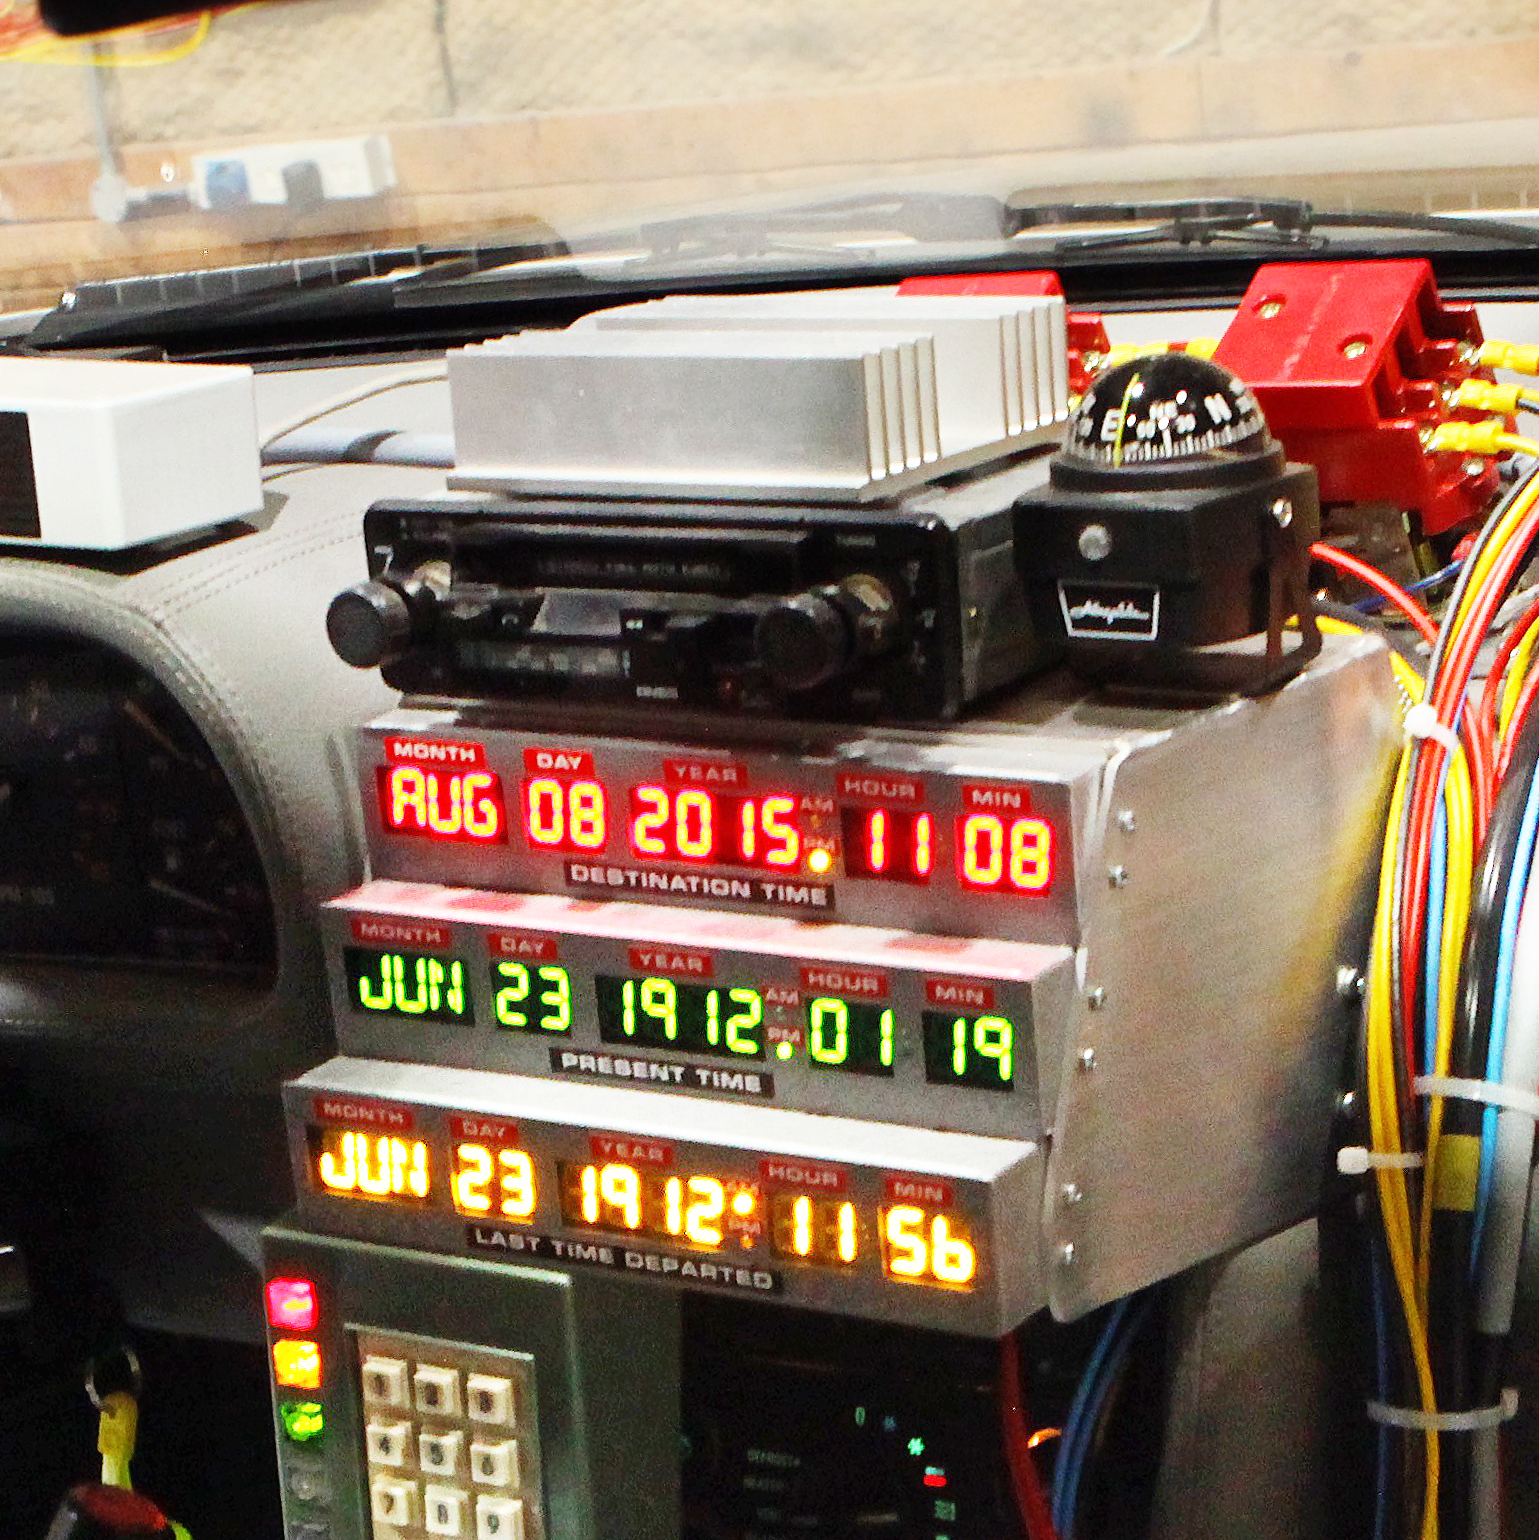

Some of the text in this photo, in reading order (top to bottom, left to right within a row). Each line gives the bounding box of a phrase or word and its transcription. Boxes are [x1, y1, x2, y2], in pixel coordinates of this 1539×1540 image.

[394, 741, 1022, 809] MONTH DAY YEAR HOUR MIN
[800, 796, 834, 813] AM
[390, 765, 499, 838] AUG
[528, 777, 606, 848] 08
[870, 808, 930, 876] 11
[963, 813, 1052, 890] 08
[570, 864, 827, 906] DESTINATION TIME
[359, 923, 984, 1005] MONTH DAY YEAR HOUR MIN
[766, 987, 800, 1005] AM
[358, 953, 465, 1015] JUN
[496, 961, 572, 1032] 23
[809, 996, 893, 1067] 01
[952, 1015, 1014, 1082] 19
[767, 1026, 802, 1042] PM
[560, 1052, 761, 1093] PRESENT TIME
[323, 1103, 944, 1201] MONTH DAY YEAR HOUR MIN
[318, 1131, 430, 1198] JUN
[456, 1142, 536, 1217] 23
[791, 1194, 857, 1263] 11
[886, 1203, 977, 1283] 56
[475, 1227, 773, 1291] LAST TIME DEPARTED
